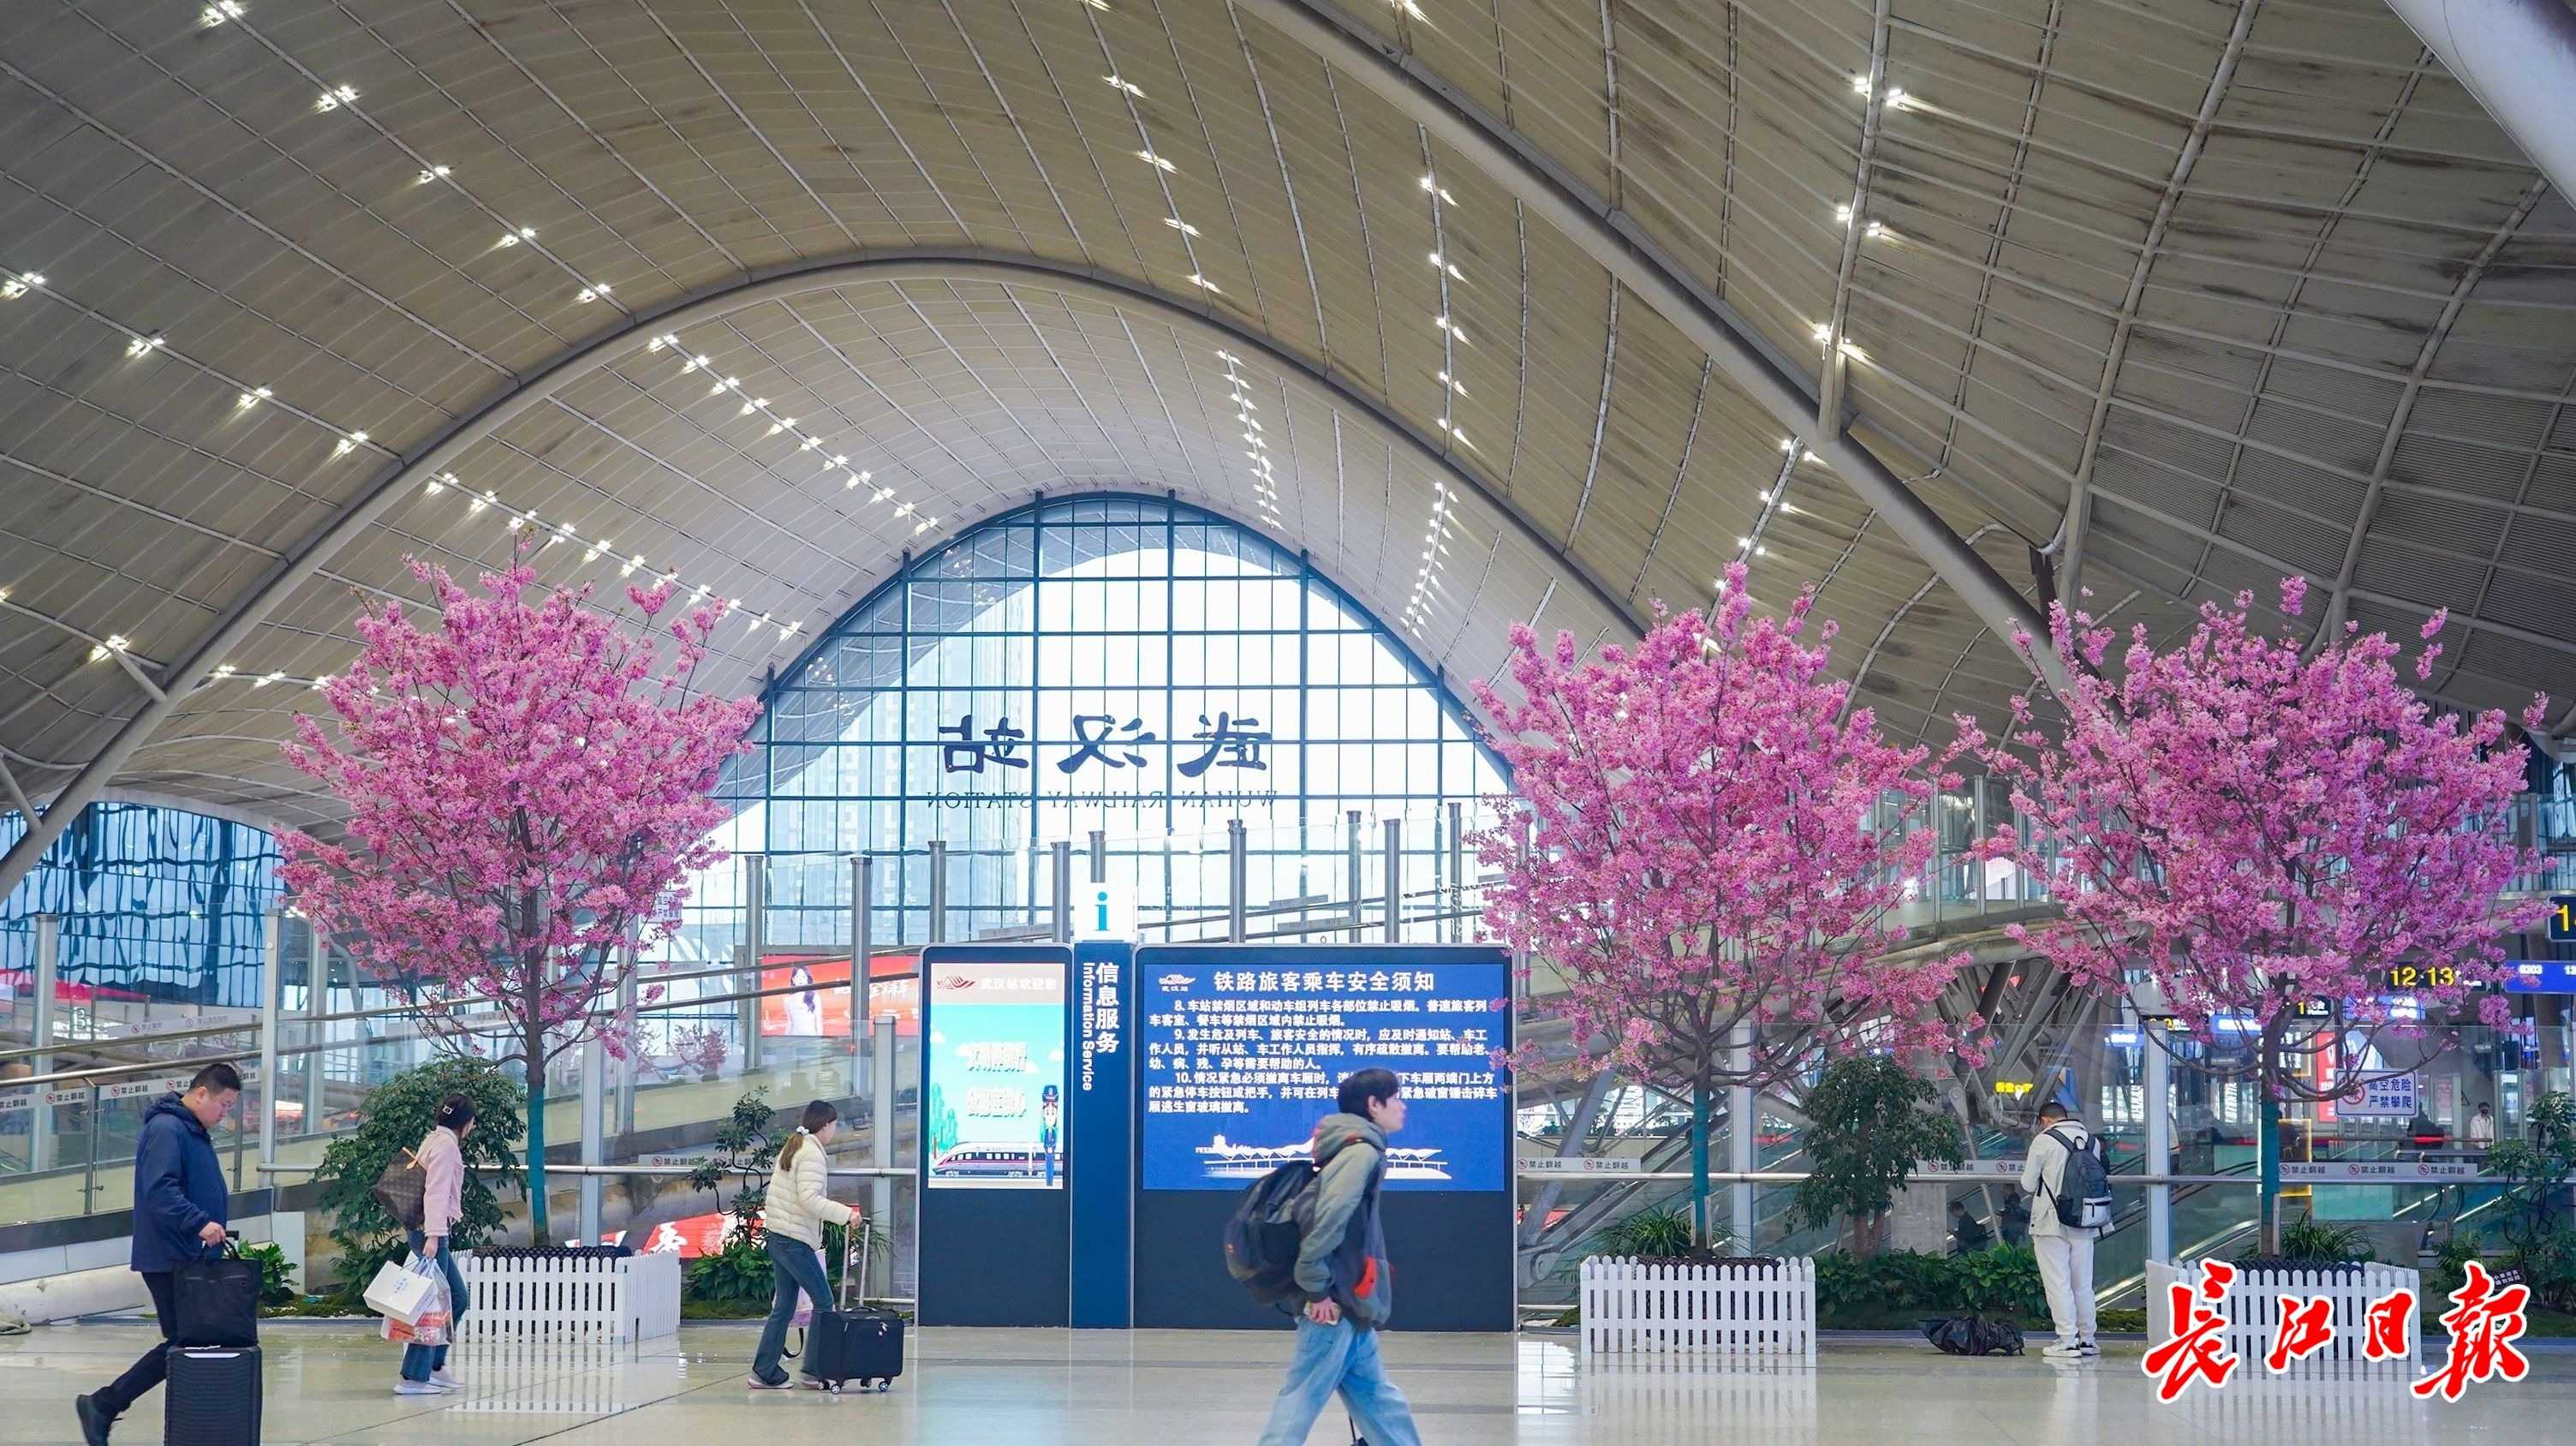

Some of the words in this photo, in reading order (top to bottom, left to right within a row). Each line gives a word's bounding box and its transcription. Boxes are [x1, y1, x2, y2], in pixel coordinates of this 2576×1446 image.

[1213, 971, 1435, 992] 铁路旅客乘车安全须知
[2390, 966, 2417, 987] 12
[2427, 966, 2454, 987] 13
[1082, 962, 1095, 1037] Information
[1095, 962, 1120, 1054] 信息服务
[1082, 1041, 1095, 1091] Service
[122, 1084, 148, 1095] 禁止翻越
[2369, 1079, 2411, 1091] 高空危险
[2369, 1096, 2412, 1108] 严禁攀爬
[2292, 1165, 2325, 1174] 禁止翻越
[2361, 1165, 2395, 1174] 禁止翻越
[2430, 1166, 2465, 1174] 禁止翻越
